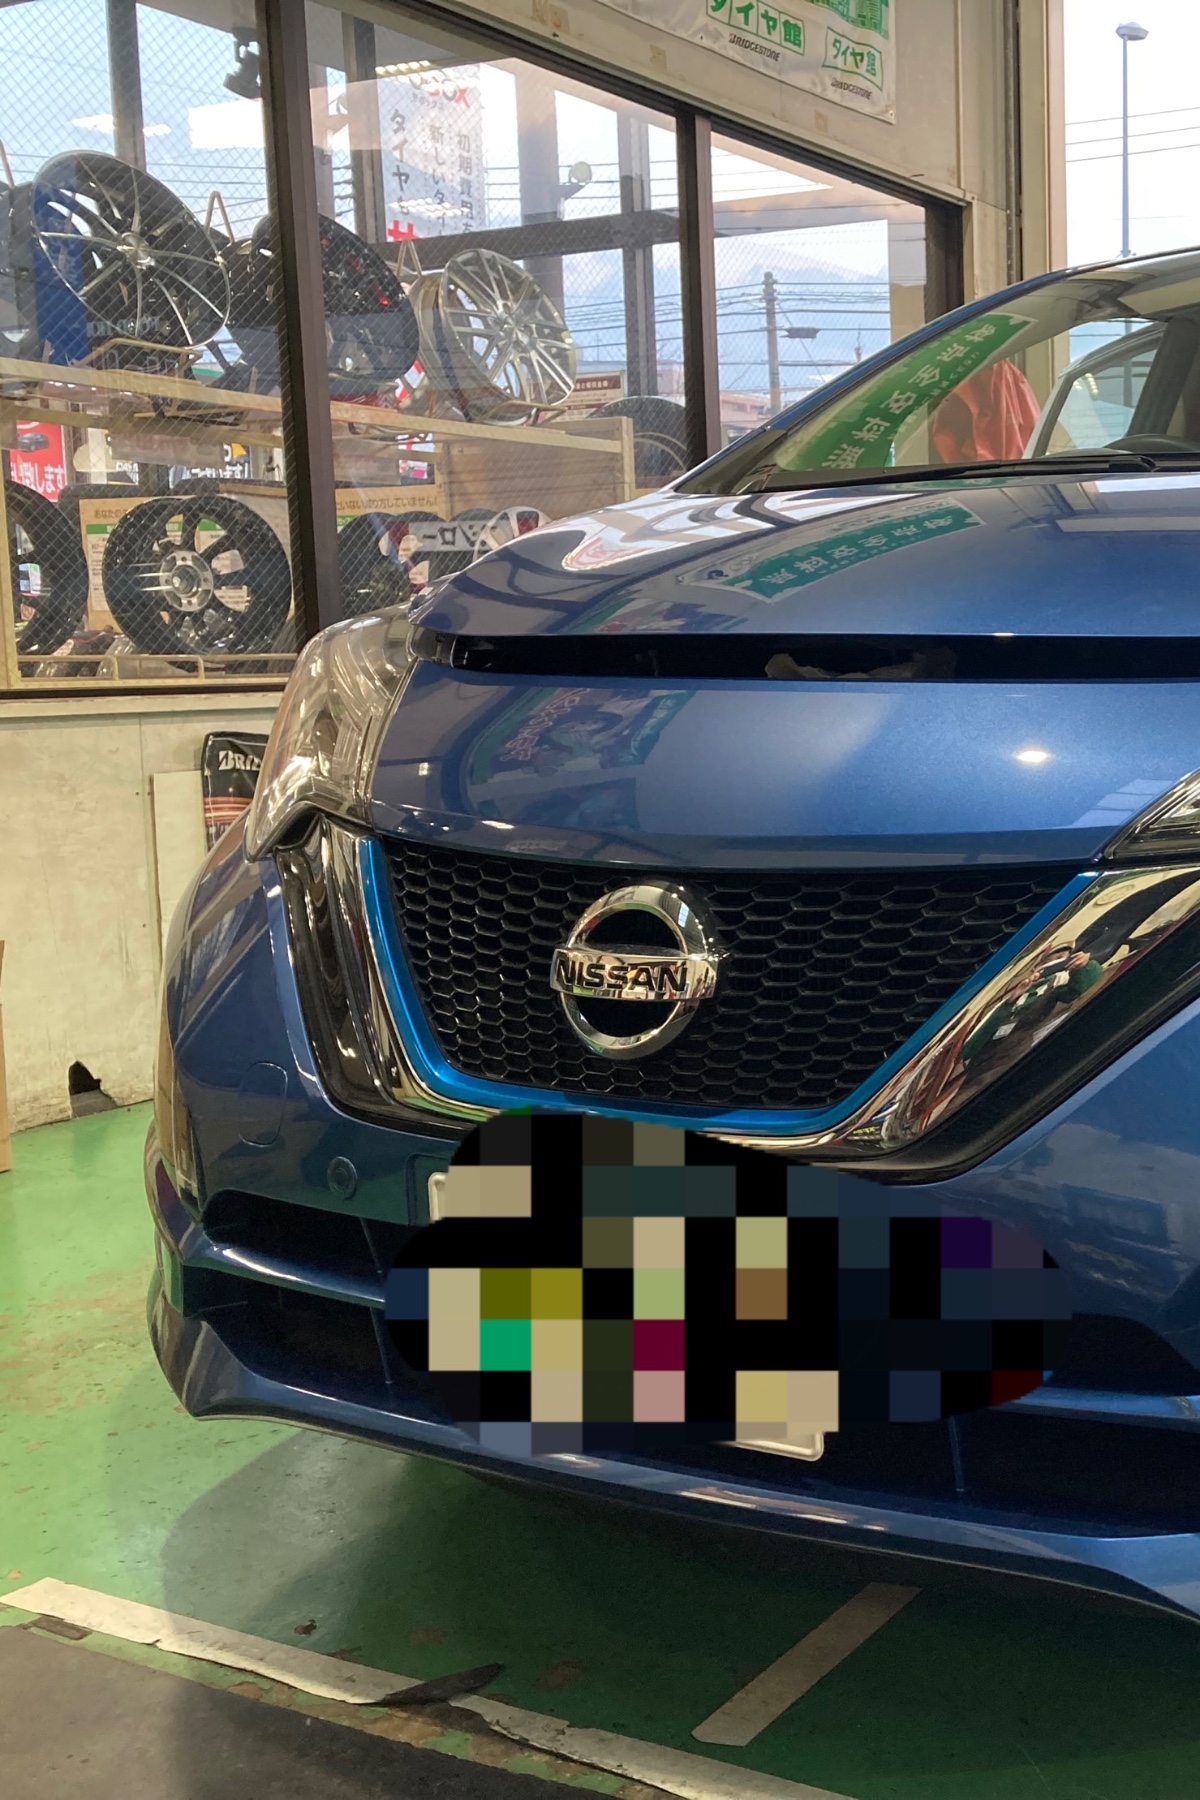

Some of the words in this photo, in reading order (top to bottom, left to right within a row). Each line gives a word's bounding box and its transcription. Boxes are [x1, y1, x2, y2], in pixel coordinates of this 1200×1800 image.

[728, 32, 781, 62] BRIDGESTONE
[831, 38, 877, 77] タイヤ館
[830, 77, 873, 100] BRIDGESTONE
[555, 957, 689, 993] NISSAN
